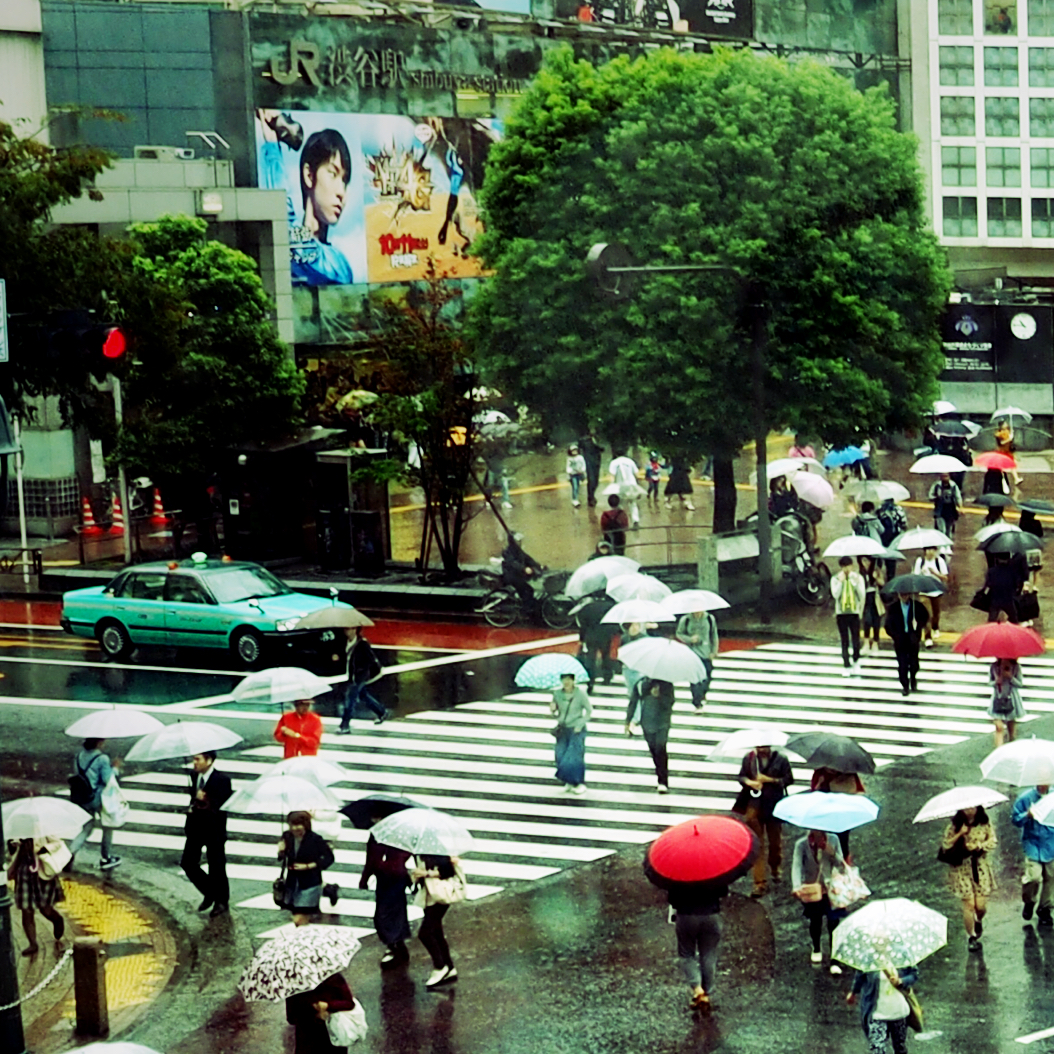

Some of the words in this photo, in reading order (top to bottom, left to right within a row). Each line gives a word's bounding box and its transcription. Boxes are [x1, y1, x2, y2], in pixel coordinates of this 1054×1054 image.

[271, 40, 322, 90] JR
[329, 45, 406, 88] 渋谷駅
